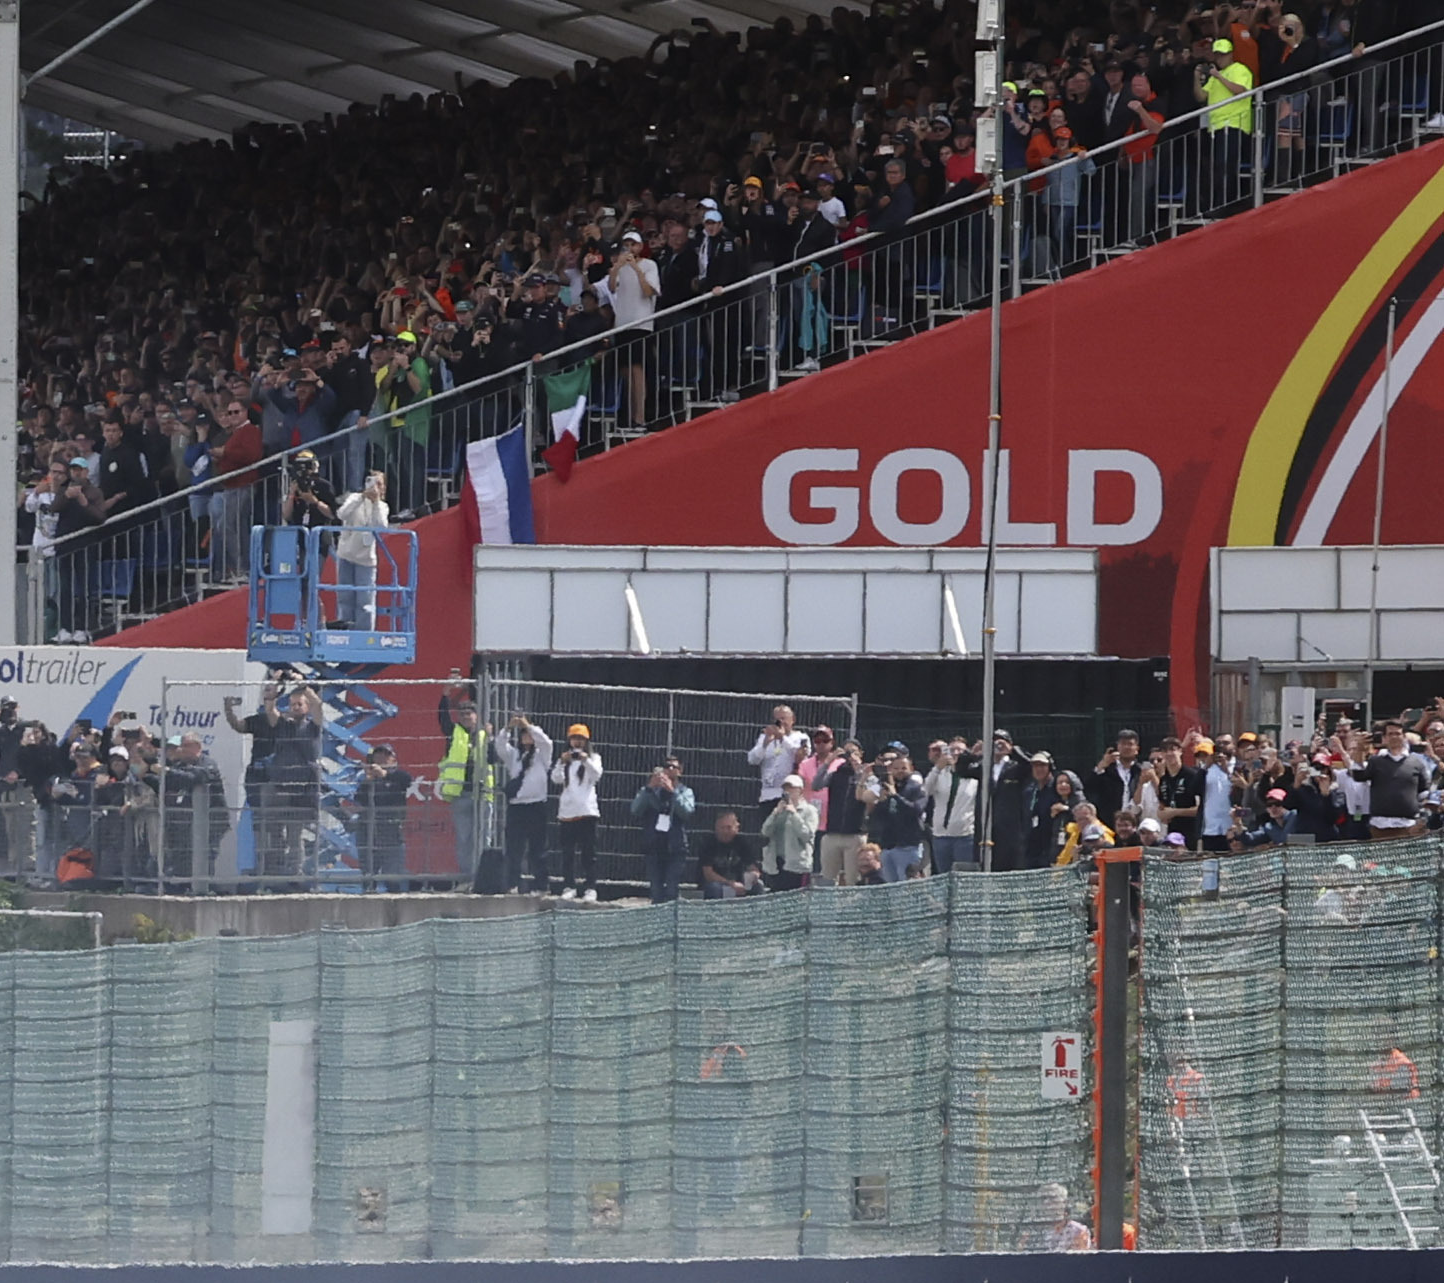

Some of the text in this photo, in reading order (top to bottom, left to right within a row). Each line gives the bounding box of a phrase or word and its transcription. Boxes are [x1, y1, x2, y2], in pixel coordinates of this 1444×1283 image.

[762, 448, 1161, 546] GOLD
[172, 705, 221, 728] huur
[1045, 1069, 1078, 1079] FIRE
